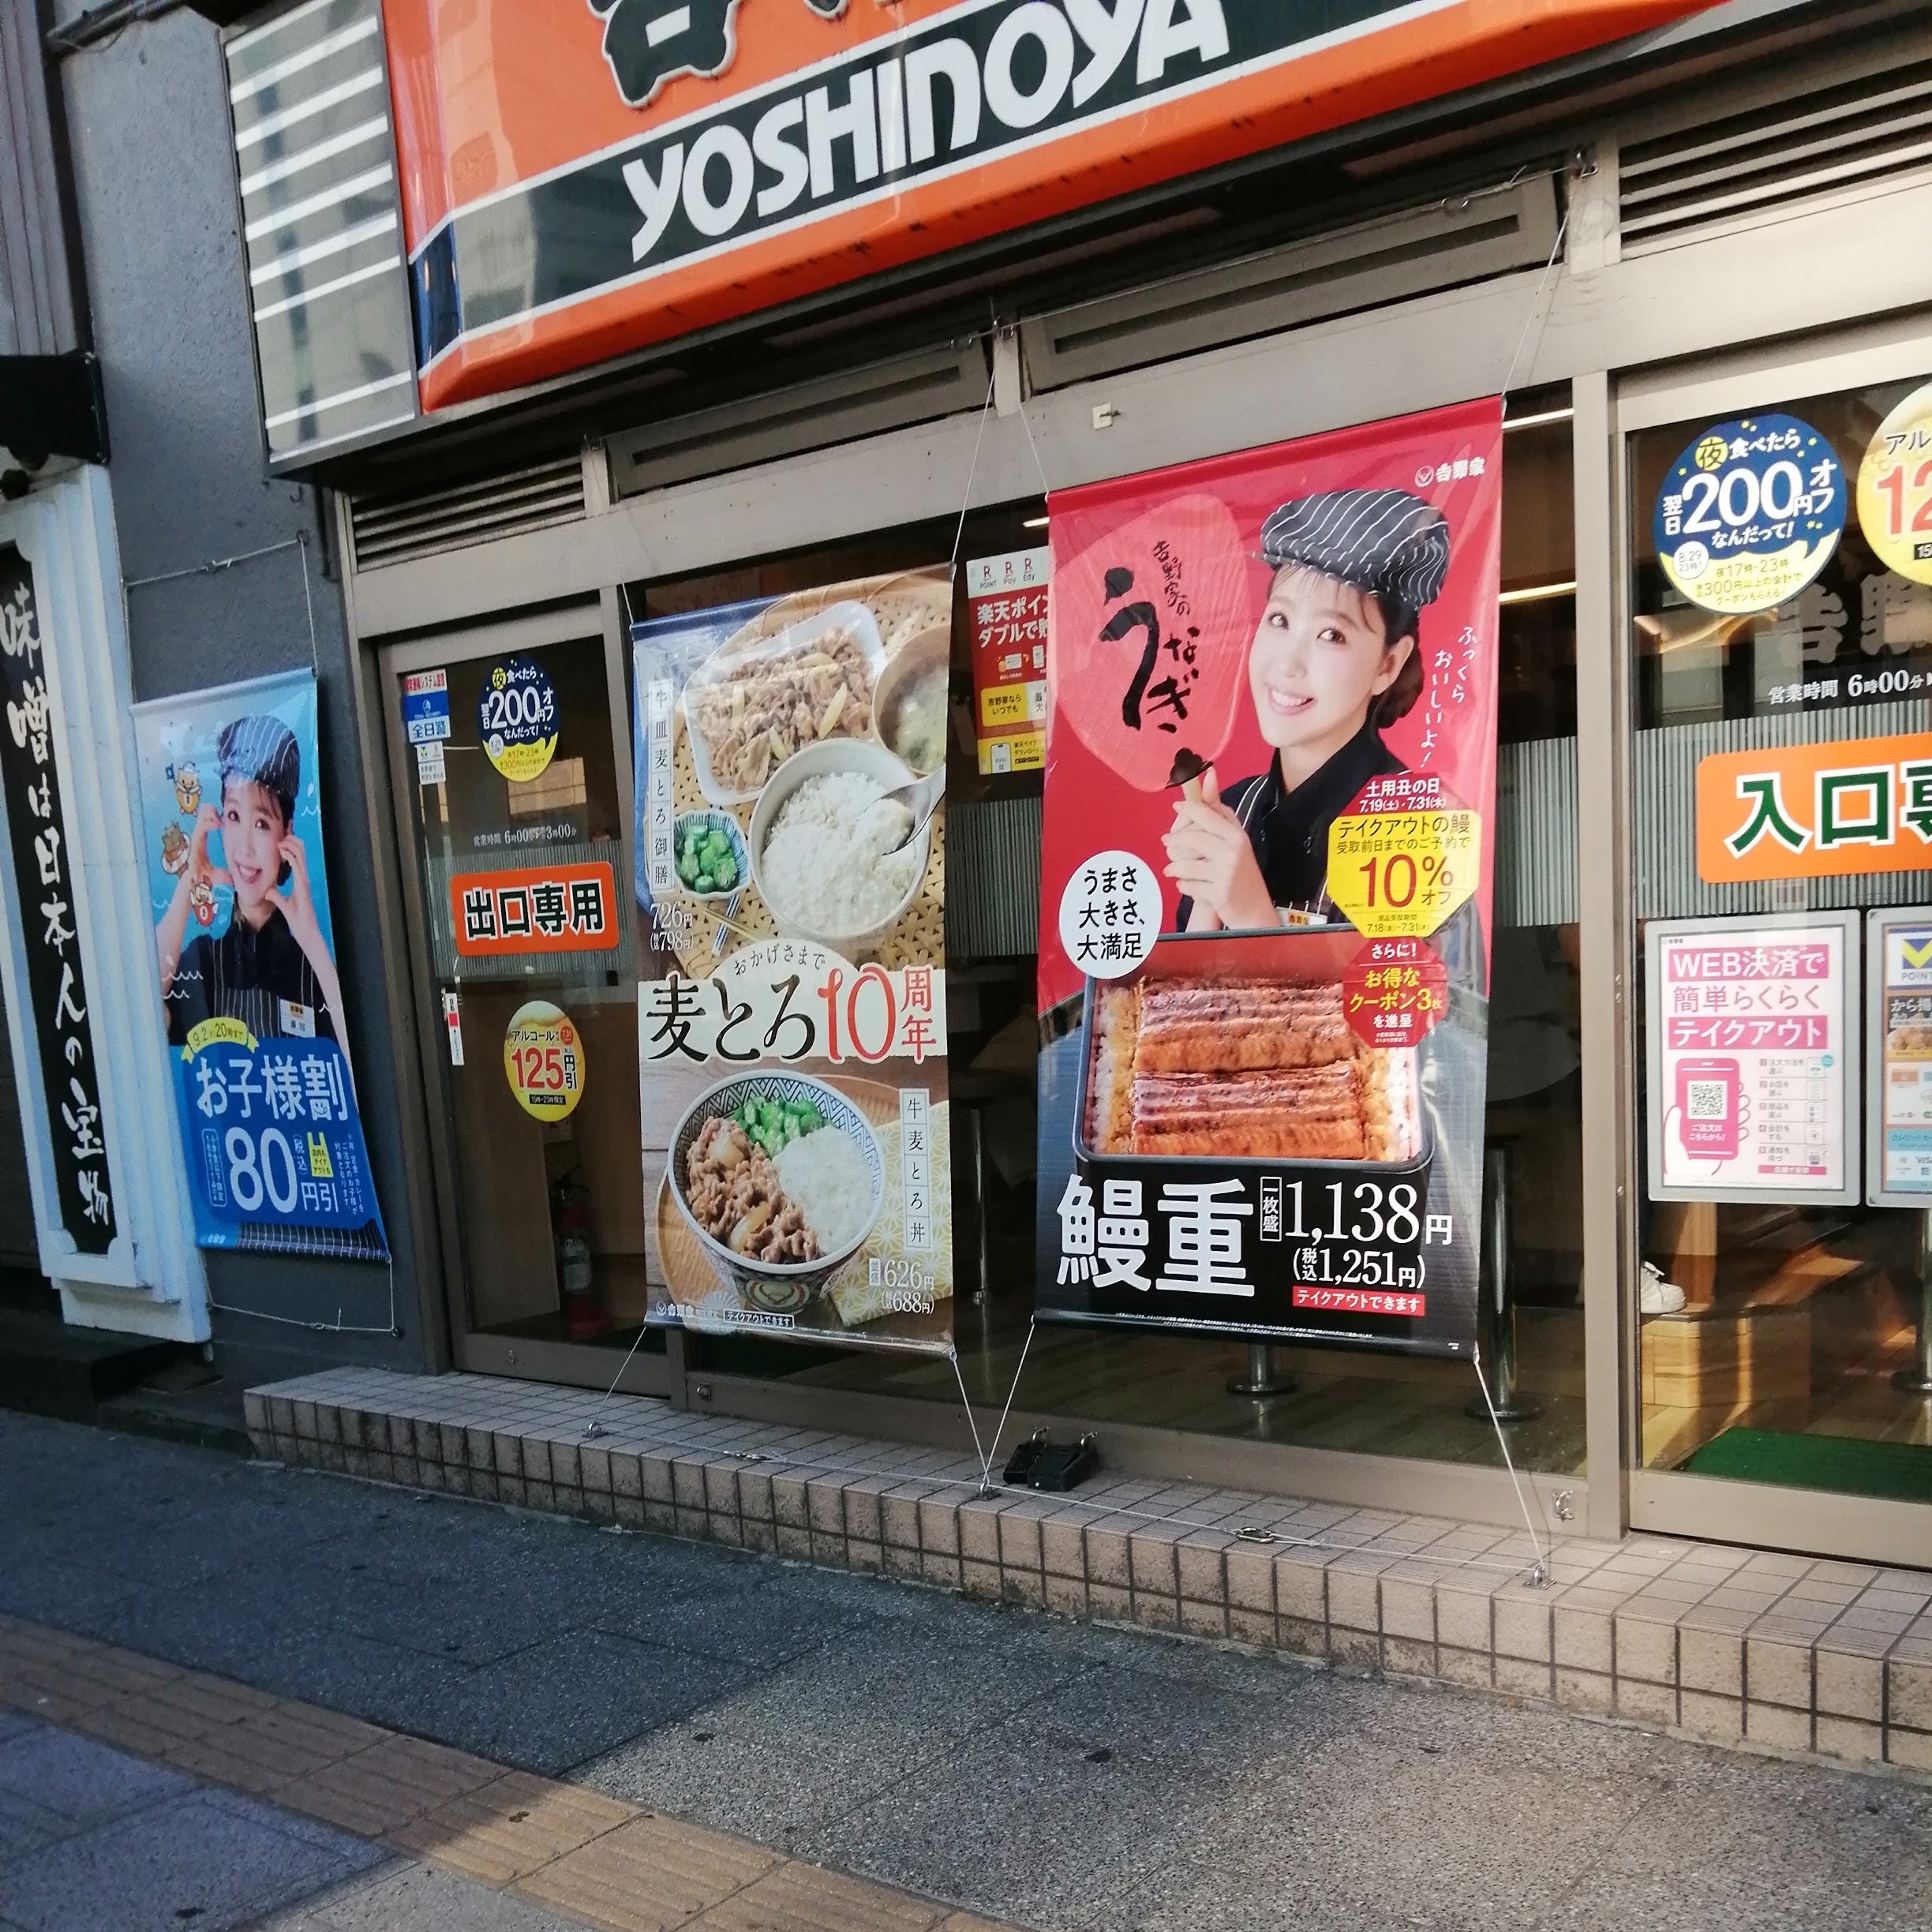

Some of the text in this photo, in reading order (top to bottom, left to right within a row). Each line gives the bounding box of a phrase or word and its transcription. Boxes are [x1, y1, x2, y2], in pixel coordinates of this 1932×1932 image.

[622, 0, 1230, 263] YOSHINOYA
[1699, 428, 1800, 470] 夜食べたら
[1153, 538, 1190, 616] 吉野家の
[1099, 566, 1200, 733] うなぎ
[1451, 627, 1477, 703] ふっくら
[1768, 680, 1838, 705] 営業時間
[653, 689, 668, 886] 牛皿麦とろ御膳
[1365, 777, 1440, 798] 土用丑の日
[1339, 814, 1470, 839] テイクアウトの鰻
[1084, 865, 1137, 895] うまさ
[462, 878, 605, 942] 出口専用
[650, 901, 693, 929] 726円
[734, 943, 826, 975] おかげさまで
[1077, 932, 1144, 962] 大満足
[1372, 942, 1417, 960] さらに!
[1365, 967, 1421, 989] お得な
[1672, 948, 1825, 978] WEB決済で
[1674, 984, 1821, 1013] 簡単らくらく
[1373, 1013, 1413, 1028] を進呈
[1672, 1018, 1822, 1047] テイクアウト
[197, 1054, 348, 1121] お子様割
[907, 1096, 924, 1244] 牛麦とろ丼
[1056, 1174, 1255, 1297] 鰻重
[1263, 1186, 1279, 1233] 一枚盛
[884, 1259, 934, 1291] 626円
[1297, 1290, 1421, 1313] テイクアウトできます
